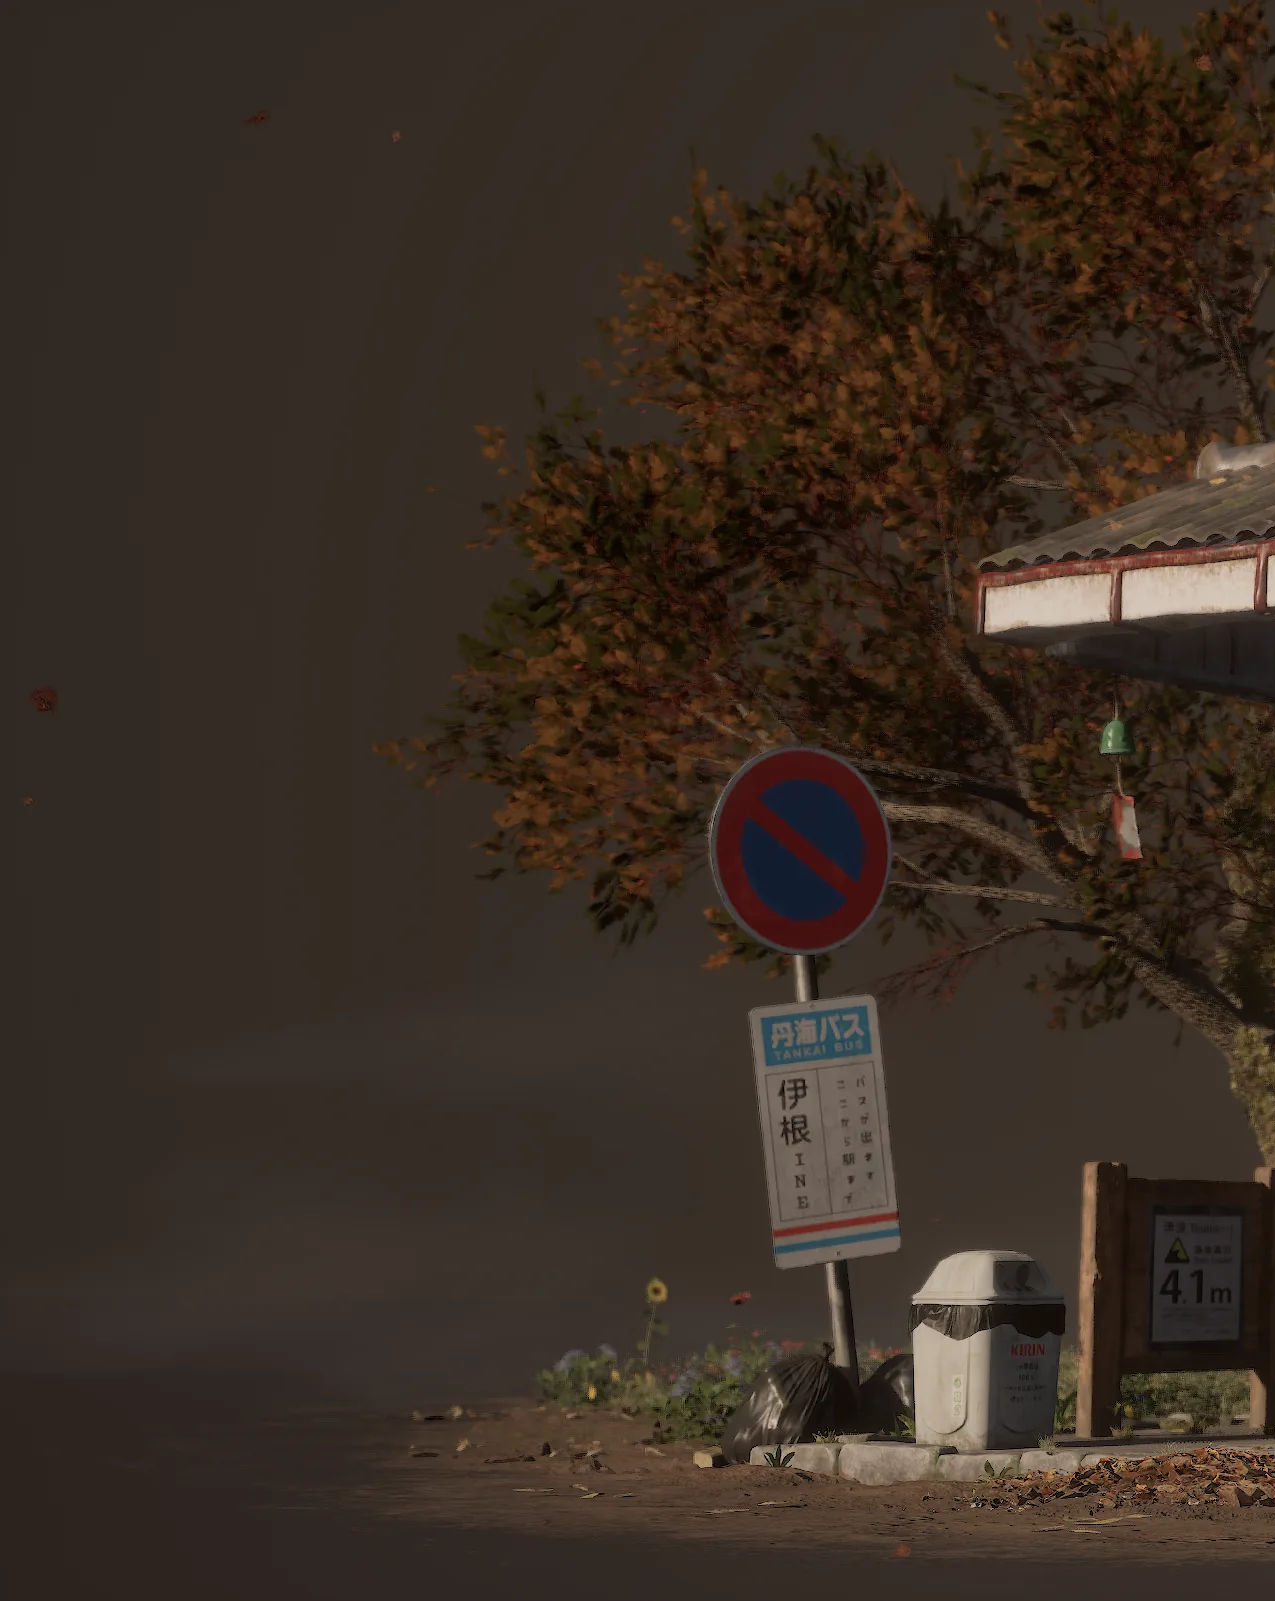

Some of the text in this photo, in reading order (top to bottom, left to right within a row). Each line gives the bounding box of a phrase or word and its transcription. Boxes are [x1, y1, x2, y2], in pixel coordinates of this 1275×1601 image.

[770, 1011, 865, 1048] 丹海バス
[774, 1040, 863, 1062] TANKAI BUS
[777, 1077, 812, 1210] 伊根 INE
[1010, 1343, 1046, 1357] KIRIN
